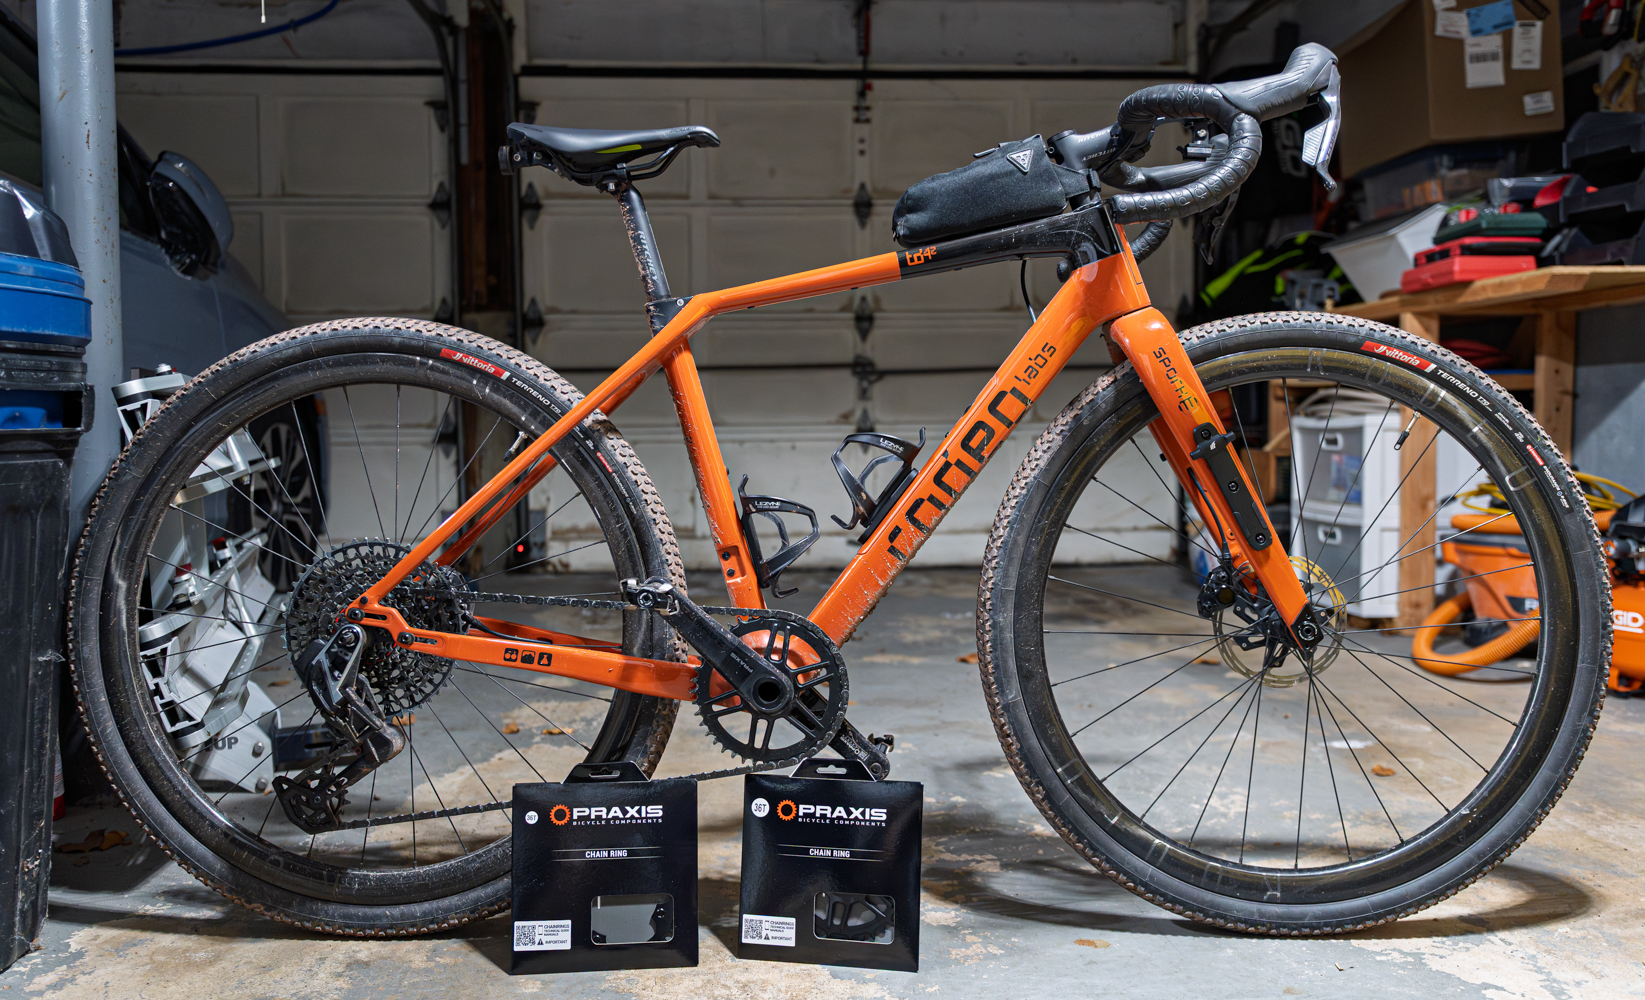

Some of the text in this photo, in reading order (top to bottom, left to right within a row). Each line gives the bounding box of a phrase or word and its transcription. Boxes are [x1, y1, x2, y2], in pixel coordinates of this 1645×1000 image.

[462, 356, 495, 373] vittoria
[512, 377, 551, 406] TERRENO
[1386, 350, 1420, 366] vittoria
[1437, 370, 1479, 398] TERRENO
[572, 805, 664, 820] PRAXIS
[754, 803, 767, 812] 36T
[799, 804, 887, 821] PRAXIS
[809, 848, 850, 858] CHAIN RING
